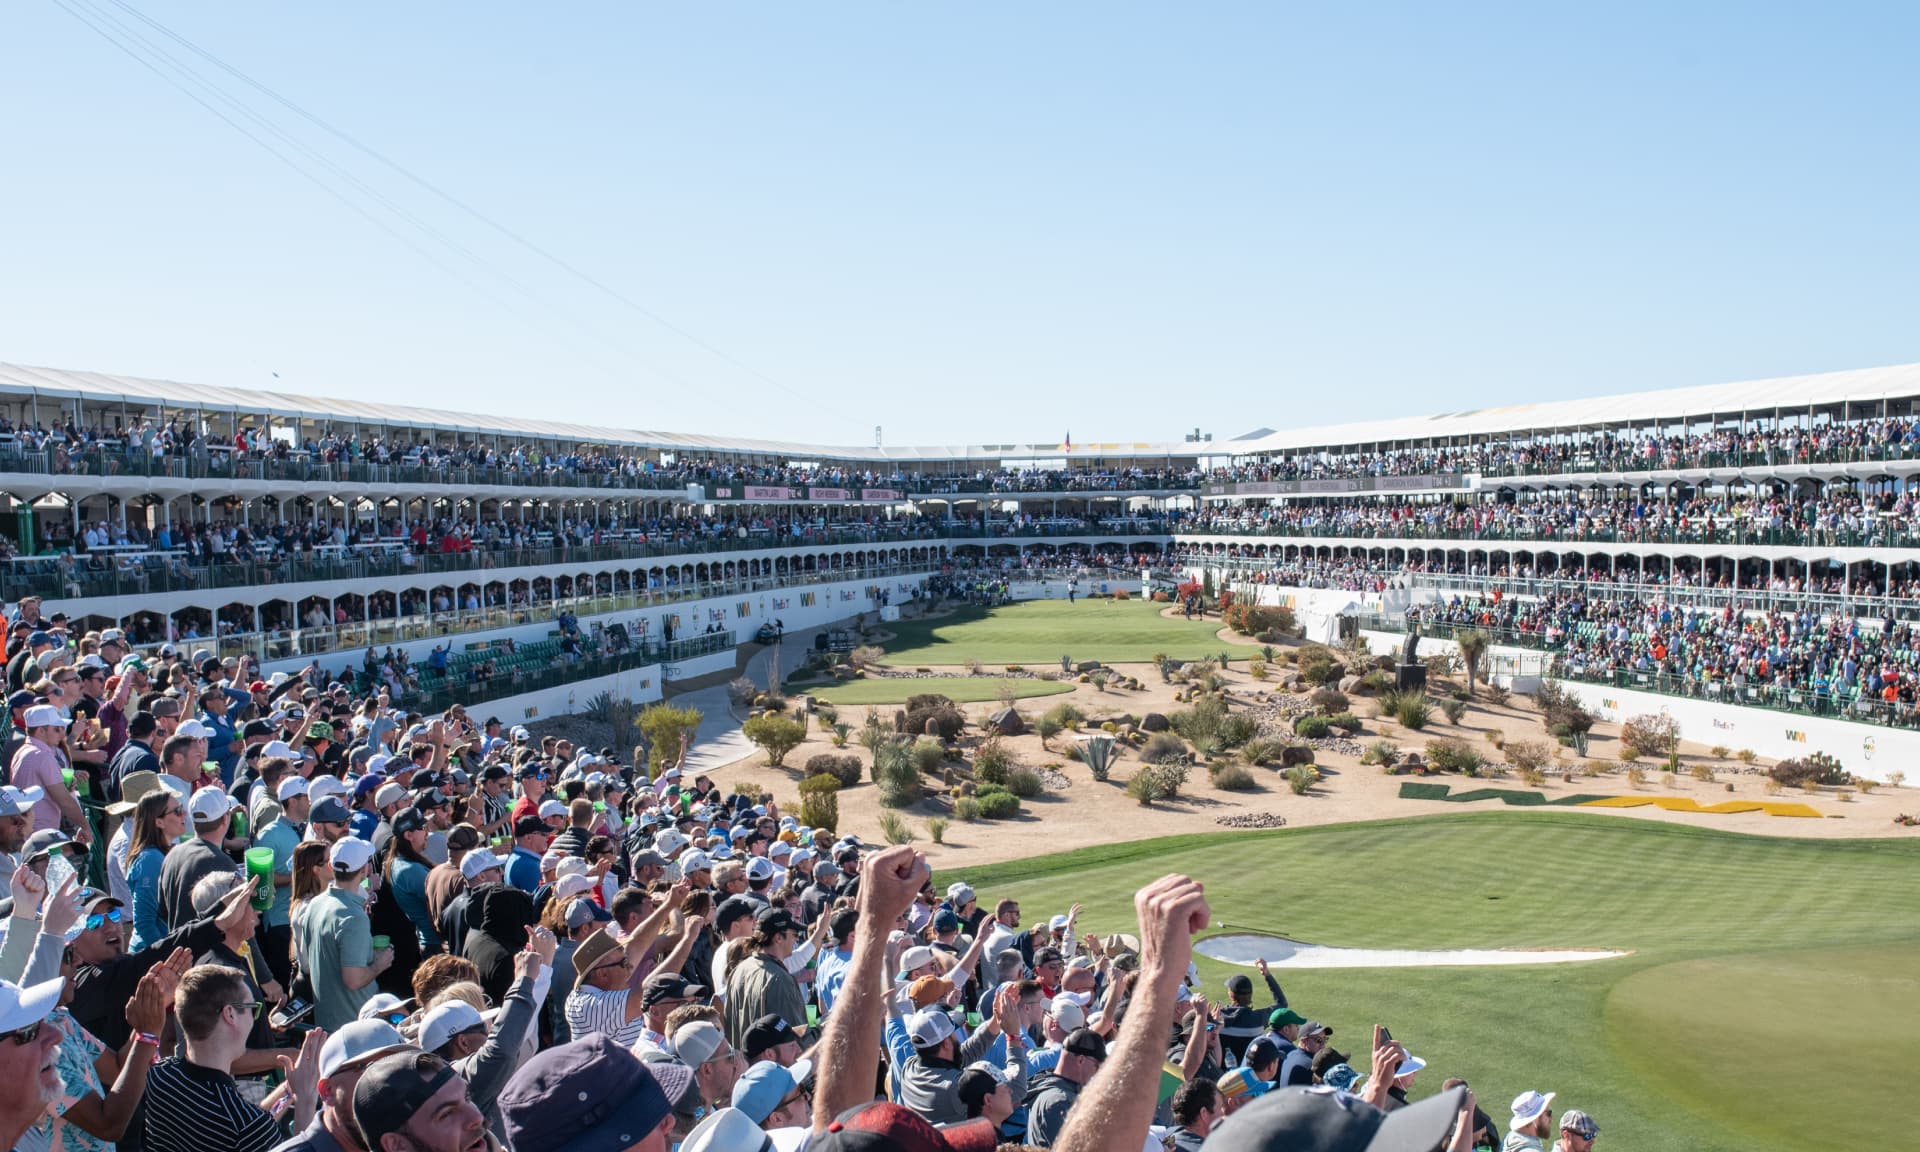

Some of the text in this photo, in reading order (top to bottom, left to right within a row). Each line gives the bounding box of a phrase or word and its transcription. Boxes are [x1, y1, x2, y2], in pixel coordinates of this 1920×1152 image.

[800, 592, 816, 607] WM
[1279, 594, 1296, 609] WM
[736, 601, 751, 618] WM
[1785, 729, 1806, 743] WM
